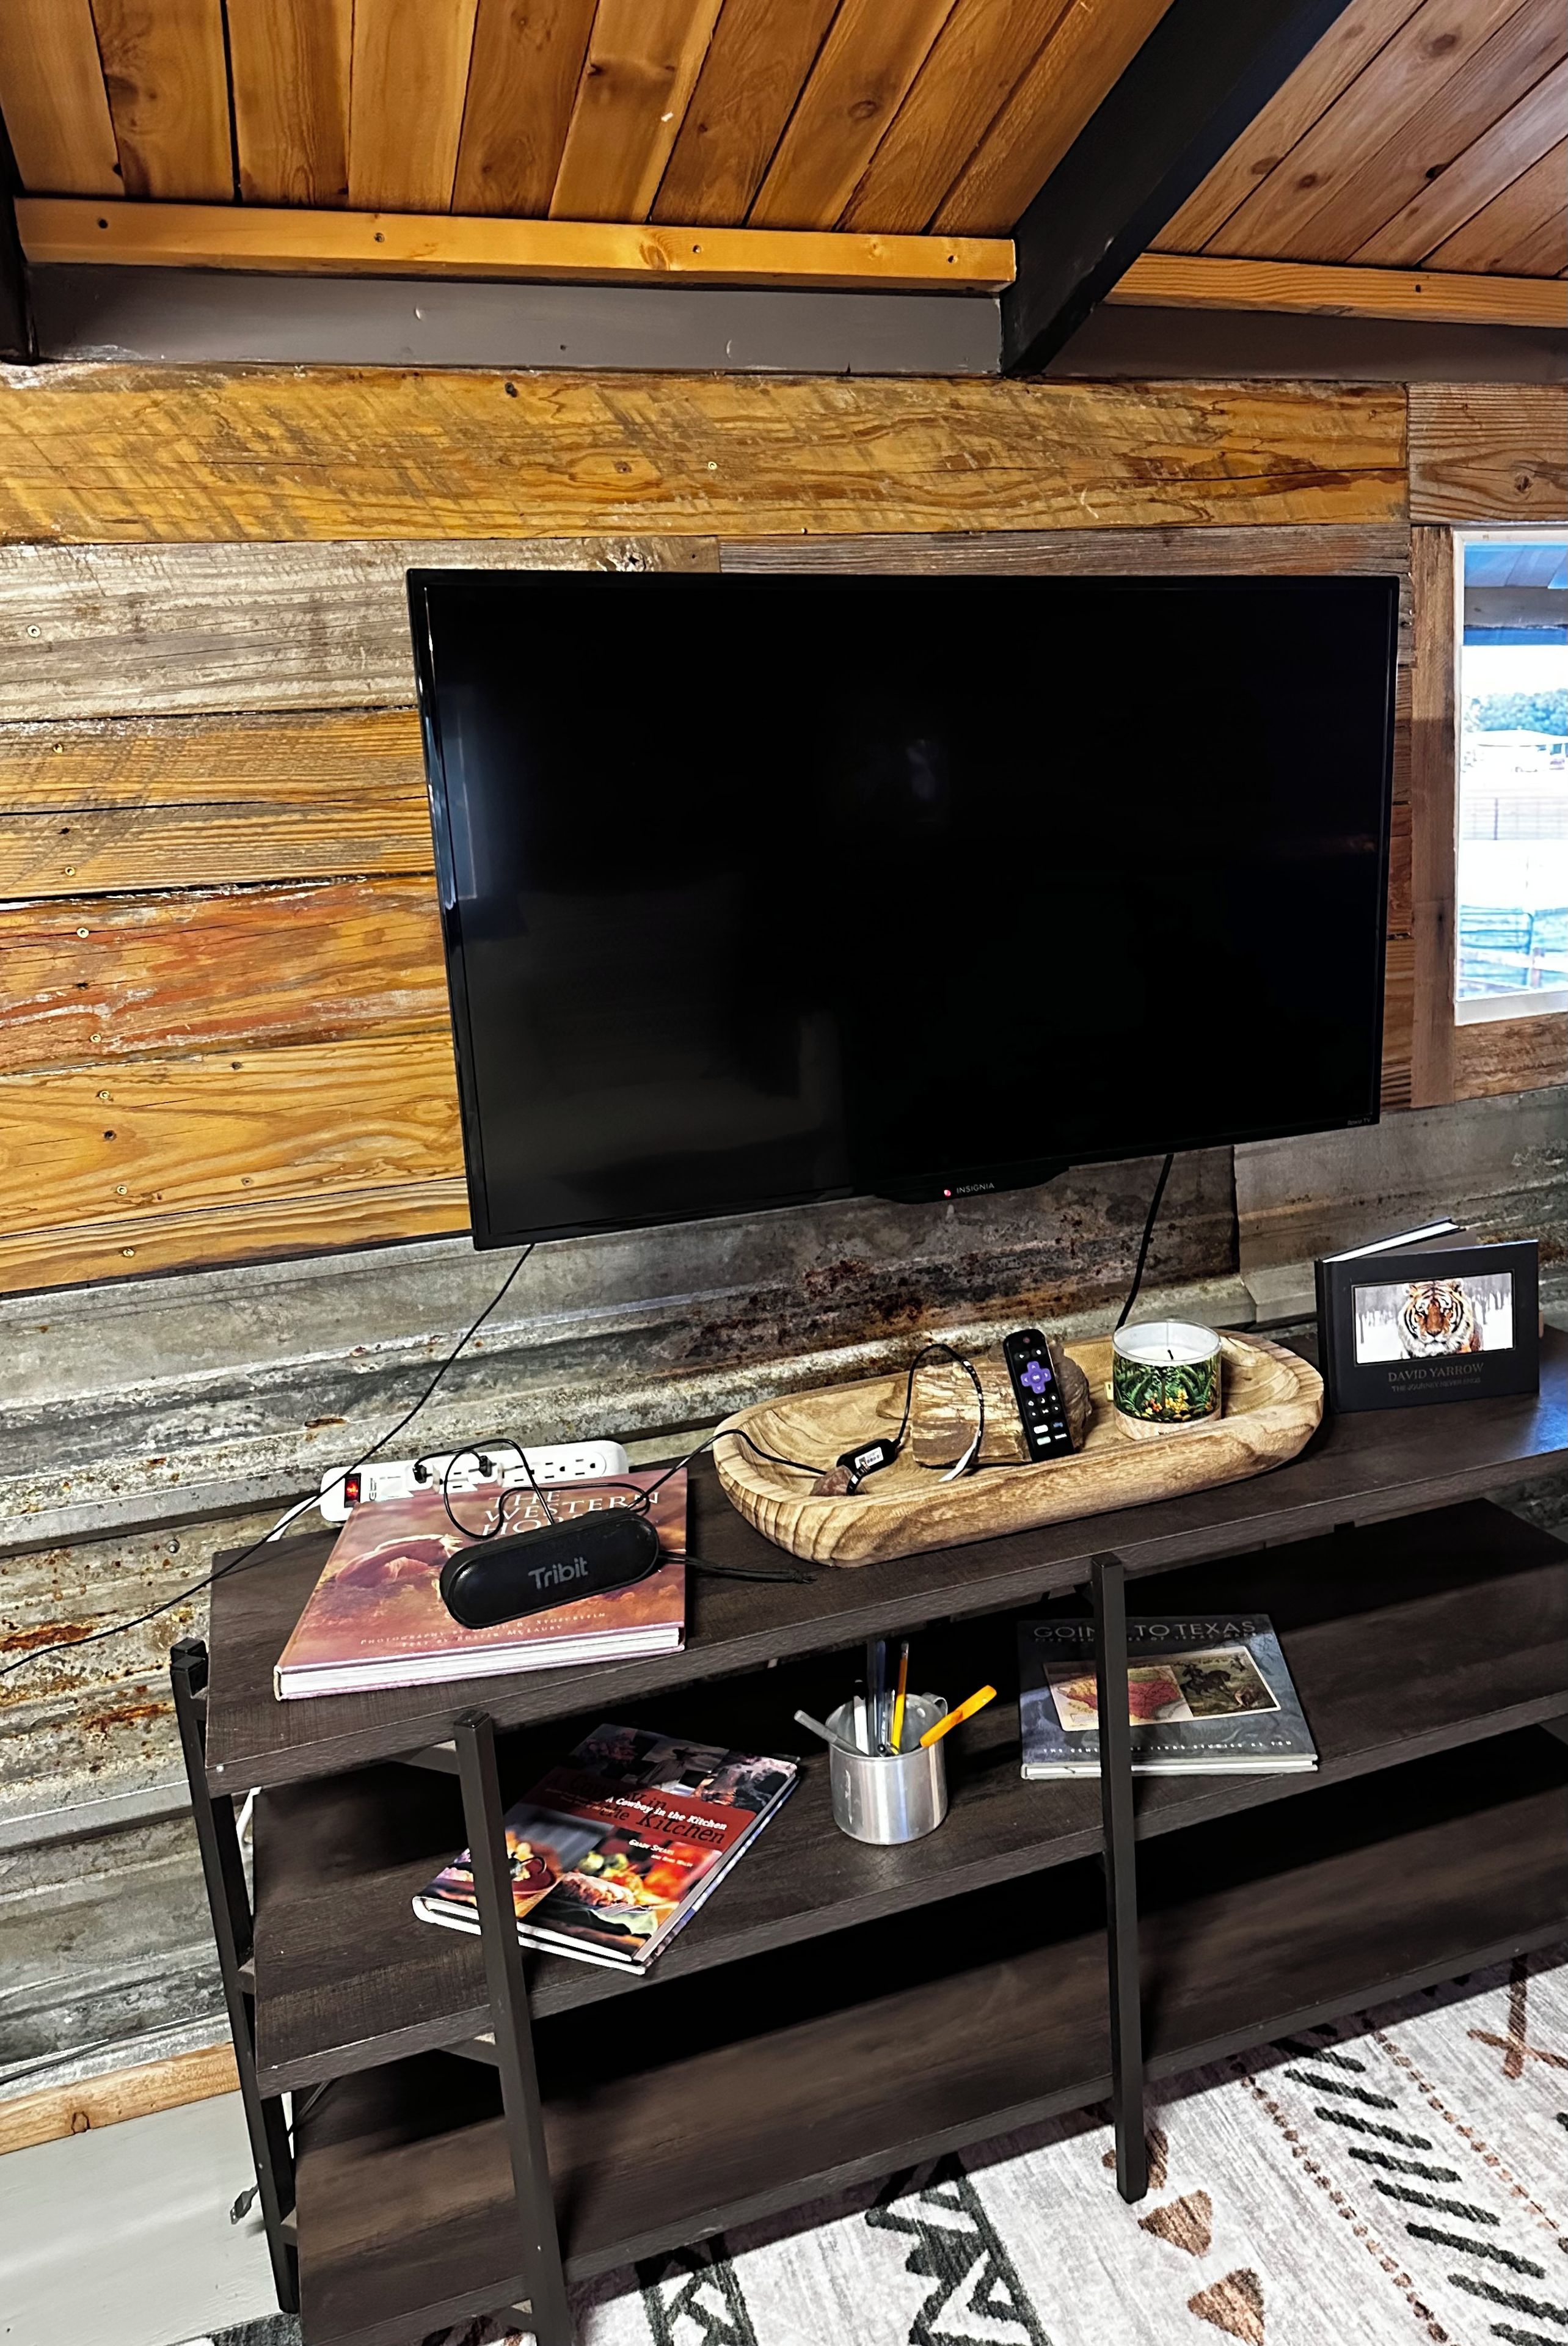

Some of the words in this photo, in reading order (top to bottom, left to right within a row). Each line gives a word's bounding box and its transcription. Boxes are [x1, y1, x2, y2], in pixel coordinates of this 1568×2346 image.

[957, 1183, 994, 1193] INSIGNIA
[1388, 1369, 1427, 1382] DAVID
[1429, 1362, 1484, 1378] YARROW
[528, 1557, 588, 1589] Tribit
[1034, 1626, 1095, 1638] GOI
[1134, 1624, 1170, 1637] TO
[1175, 1621, 1255, 1636] TEXAS
[615, 1798, 654, 1814] Cowboy
[654, 1807, 666, 1816] in
[667, 1811, 686, 1821] the
[687, 1815, 727, 1830] Kitchen
[636, 1809, 724, 1844] Kitchen
